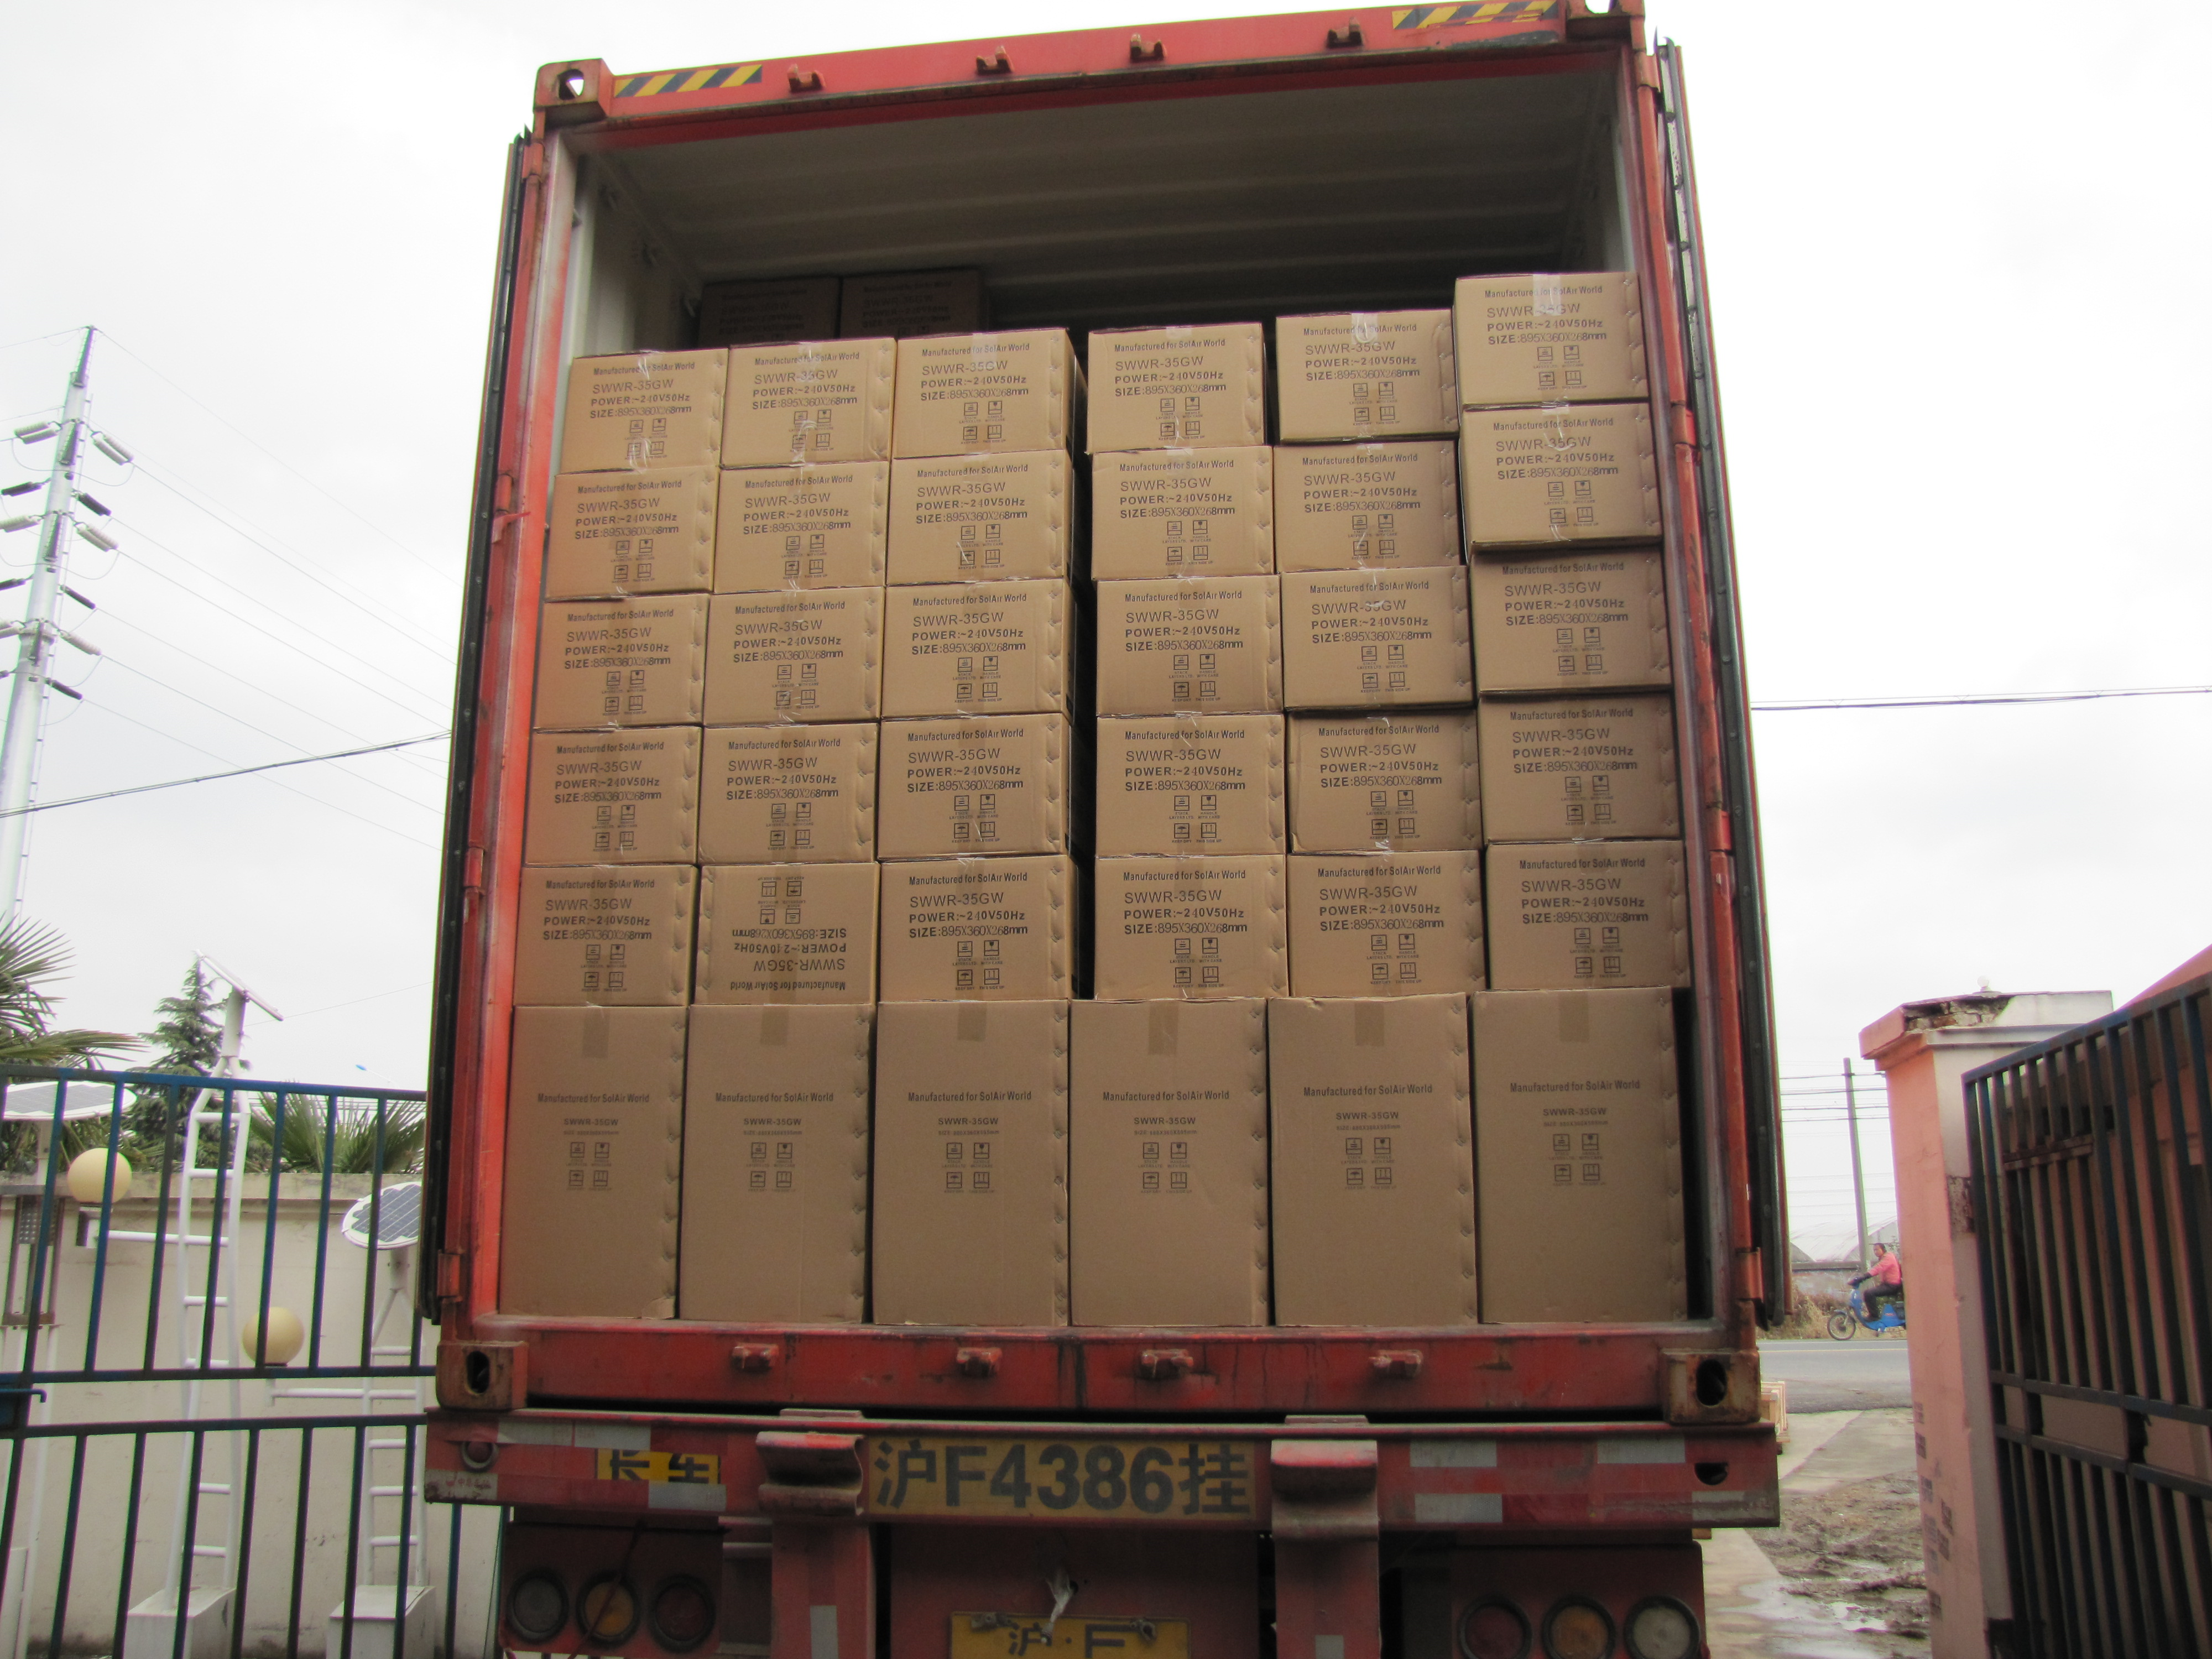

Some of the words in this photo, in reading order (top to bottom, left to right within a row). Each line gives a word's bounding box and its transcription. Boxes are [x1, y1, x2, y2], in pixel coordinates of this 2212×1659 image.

[922, 346, 971, 357] Manufactured
[1008, 343, 1030, 352] World
[1114, 341, 1165, 352] Manufactured
[1167, 341, 1177, 349] for
[1178, 340, 1202, 348] SolAir
[1203, 338, 1225, 347] World
[922, 360, 1008, 375] SWWR-35GW
[1115, 356, 1204, 371] SWWR-35GW
[1302, 455, 1355, 466] Manufactured
[1357, 455, 1368, 463] for
[1369, 455, 1394, 463] SolAir
[1395, 453, 1418, 462] World
[917, 467, 967, 478] Manufactured
[969, 466, 979, 474] for
[981, 465, 1005, 474] SolAir
[1006, 464, 1028, 473] World
[1304, 471, 1396, 486] SWWR-35GW
[578, 483, 625, 494] Manufactured
[626, 482, 637, 491] for
[638, 481, 660, 490] SolAir
[661, 479, 682, 488] World
[917, 482, 1006, 498] SWWR-35GW
[577, 497, 660, 514] SWWR-35GW
[1503, 564, 1558, 576] Manufactured
[1559, 564, 1571, 573] for
[1573, 564, 1599, 572] SolAir
[1599, 562, 1624, 571] World
[1505, 581, 1602, 597] SWWR-35GW
[1125, 592, 1178, 602] Manufactured
[1180, 591, 1191, 600] for
[1193, 591, 1218, 600] SolAir
[1219, 590, 1242, 599] World
[735, 603, 785, 614] Manufactured
[786, 603, 797, 612] for
[799, 602, 822, 611] SolAir
[823, 601, 845, 610] World
[1126, 609, 1219, 623] SWWR-35GW
[735, 619, 823, 635] SWWR-35GW
[907, 731, 960, 742] Manufactured
[962, 730, 973, 739] for
[975, 729, 999, 739] SolAir
[1000, 728, 1024, 738] World
[1318, 726, 1374, 737] Manufactured
[1375, 726, 1386, 734] for
[1389, 726, 1414, 734] SolAir
[1415, 724, 1439, 734] World
[557, 743, 606, 754] Manufactured
[607, 743, 617, 752] for
[619, 743, 641, 752] SolAir
[642, 742, 664, 750] World
[1320, 743, 1417, 758] SWWR-35GW
[908, 748, 1000, 764] SWWR-35GW
[556, 760, 642, 775] SWWR-35GW
[1123, 870, 1179, 881] Manufactured
[1181, 870, 1192, 879] for
[1194, 870, 1220, 879] SolAir
[1222, 870, 1246, 879] World
[1318, 867, 1374, 878] Manufactured
[1376, 867, 1387, 875] for
[1389, 866, 1416, 875] SolAir
[1416, 865, 1441, 875] World
[1124, 889, 1222, 904] SWWR-35GW
[1319, 885, 1418, 901] SWWR-35GW
[753, 958, 844, 971] SWWR-35GW
[729, 981, 753, 990] World
[754, 981, 778, 990] SolAir
[780, 981, 790, 990] for
[792, 980, 845, 990] Manufactured
[1303, 1086, 1362, 1097] Manufactured
[1364, 1086, 1376, 1095] for
[1379, 1084, 1405, 1094] SolAir
[1407, 1084, 1433, 1094] World
[1510, 1082, 1569, 1092] Manufactured
[1572, 1081, 1584, 1091] for
[1585, 1081, 1613, 1091] SolAir
[1614, 1079, 1640, 1089] World
[538, 1093, 588, 1103] Manufactured
[590, 1094, 601, 1103] for
[602, 1094, 625, 1103] SolAir
[627, 1094, 650, 1103] World
[716, 1093, 769, 1102] Manufactured
[771, 1093, 782, 1102] for
[784, 1093, 808, 1102] SolAir
[810, 1093, 834, 1102] World
[908, 1092, 964, 1102] Manufactured
[966, 1092, 978, 1101] for
[979, 1092, 1005, 1101] SolAir
[1007, 1091, 1031, 1100] World
[1103, 1092, 1160, 1101] Manufactured
[1162, 1091, 1175, 1100] for
[1176, 1091, 1202, 1100] SolAir
[1204, 1091, 1229, 1100] World
[1335, 1112, 1399, 1120] SWWR-35GW
[1543, 1108, 1607, 1116] SWWR-35GW
[874, 1439, 1250, 1516] 沪F4386挂
